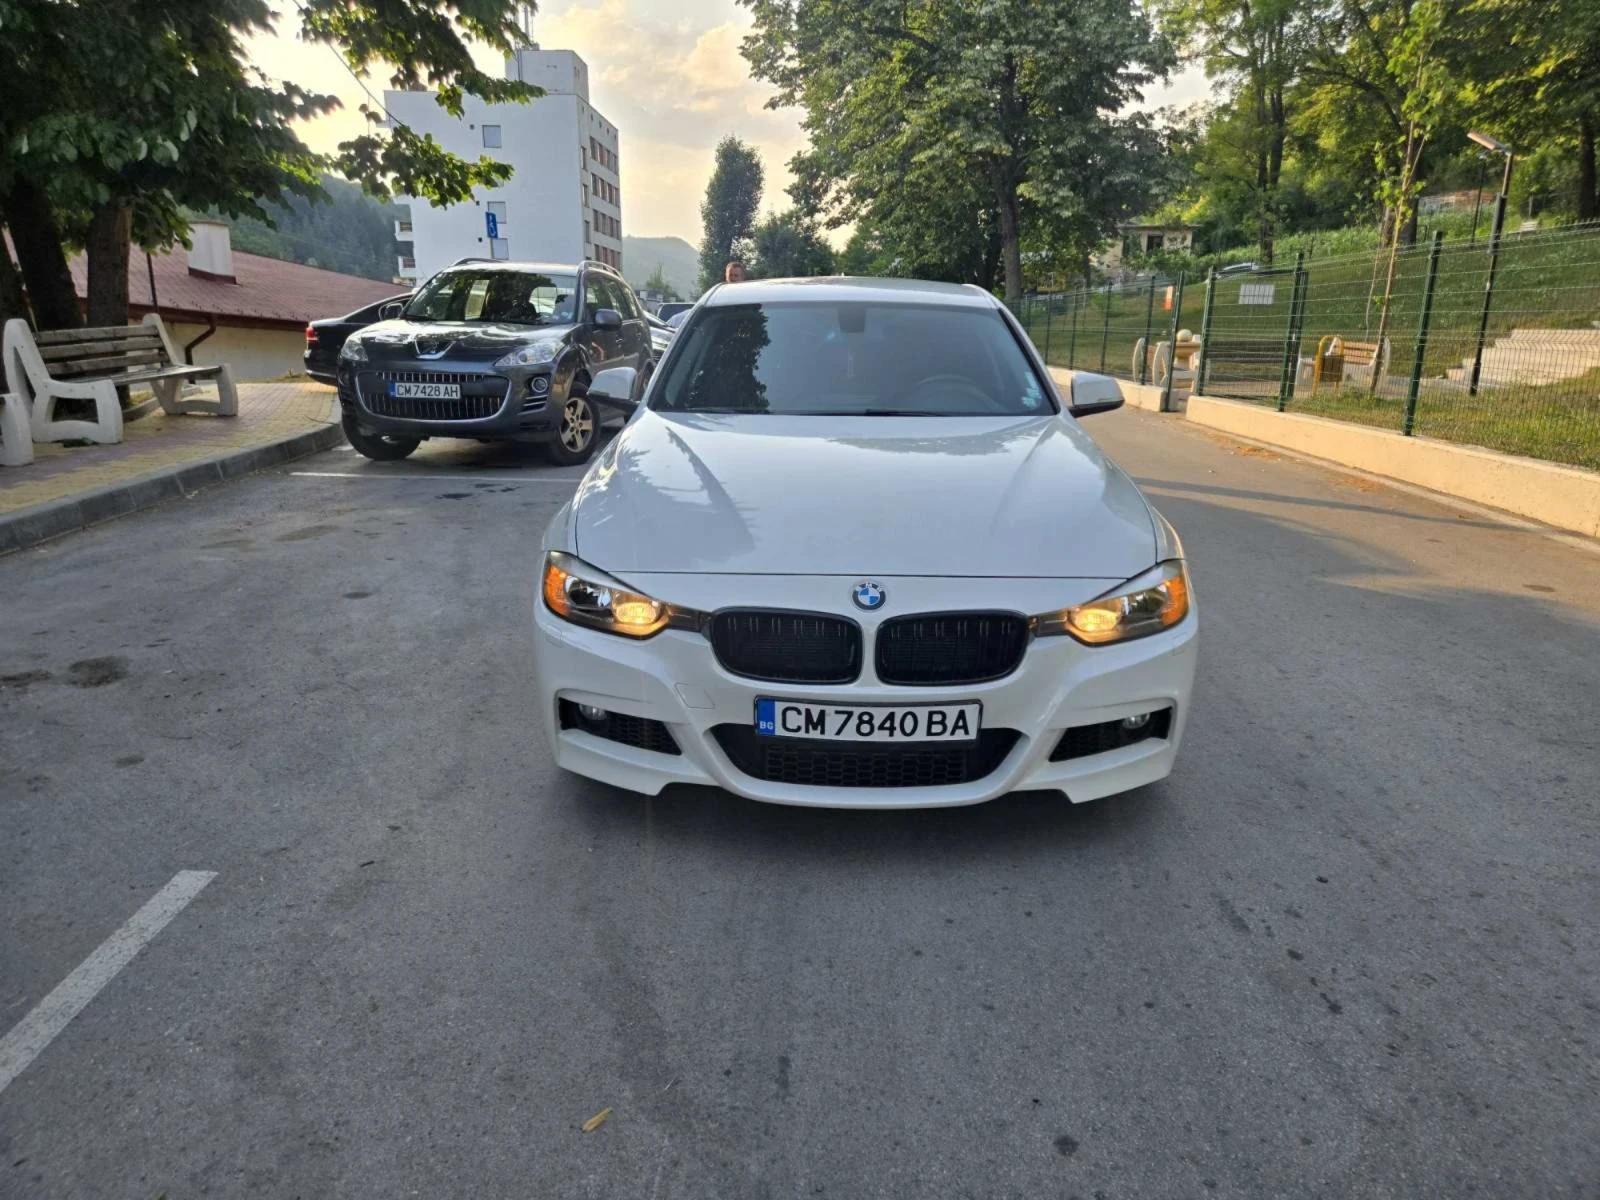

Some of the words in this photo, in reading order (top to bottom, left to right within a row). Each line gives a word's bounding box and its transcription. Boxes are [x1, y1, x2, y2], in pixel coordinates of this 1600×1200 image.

[397, 385, 412, 396] CM
[413, 385, 441, 397] 7428
[443, 386, 458, 397] AH
[781, 706, 826, 735] CM
[834, 710, 919, 737] 7840
[926, 709, 970, 737] BA
